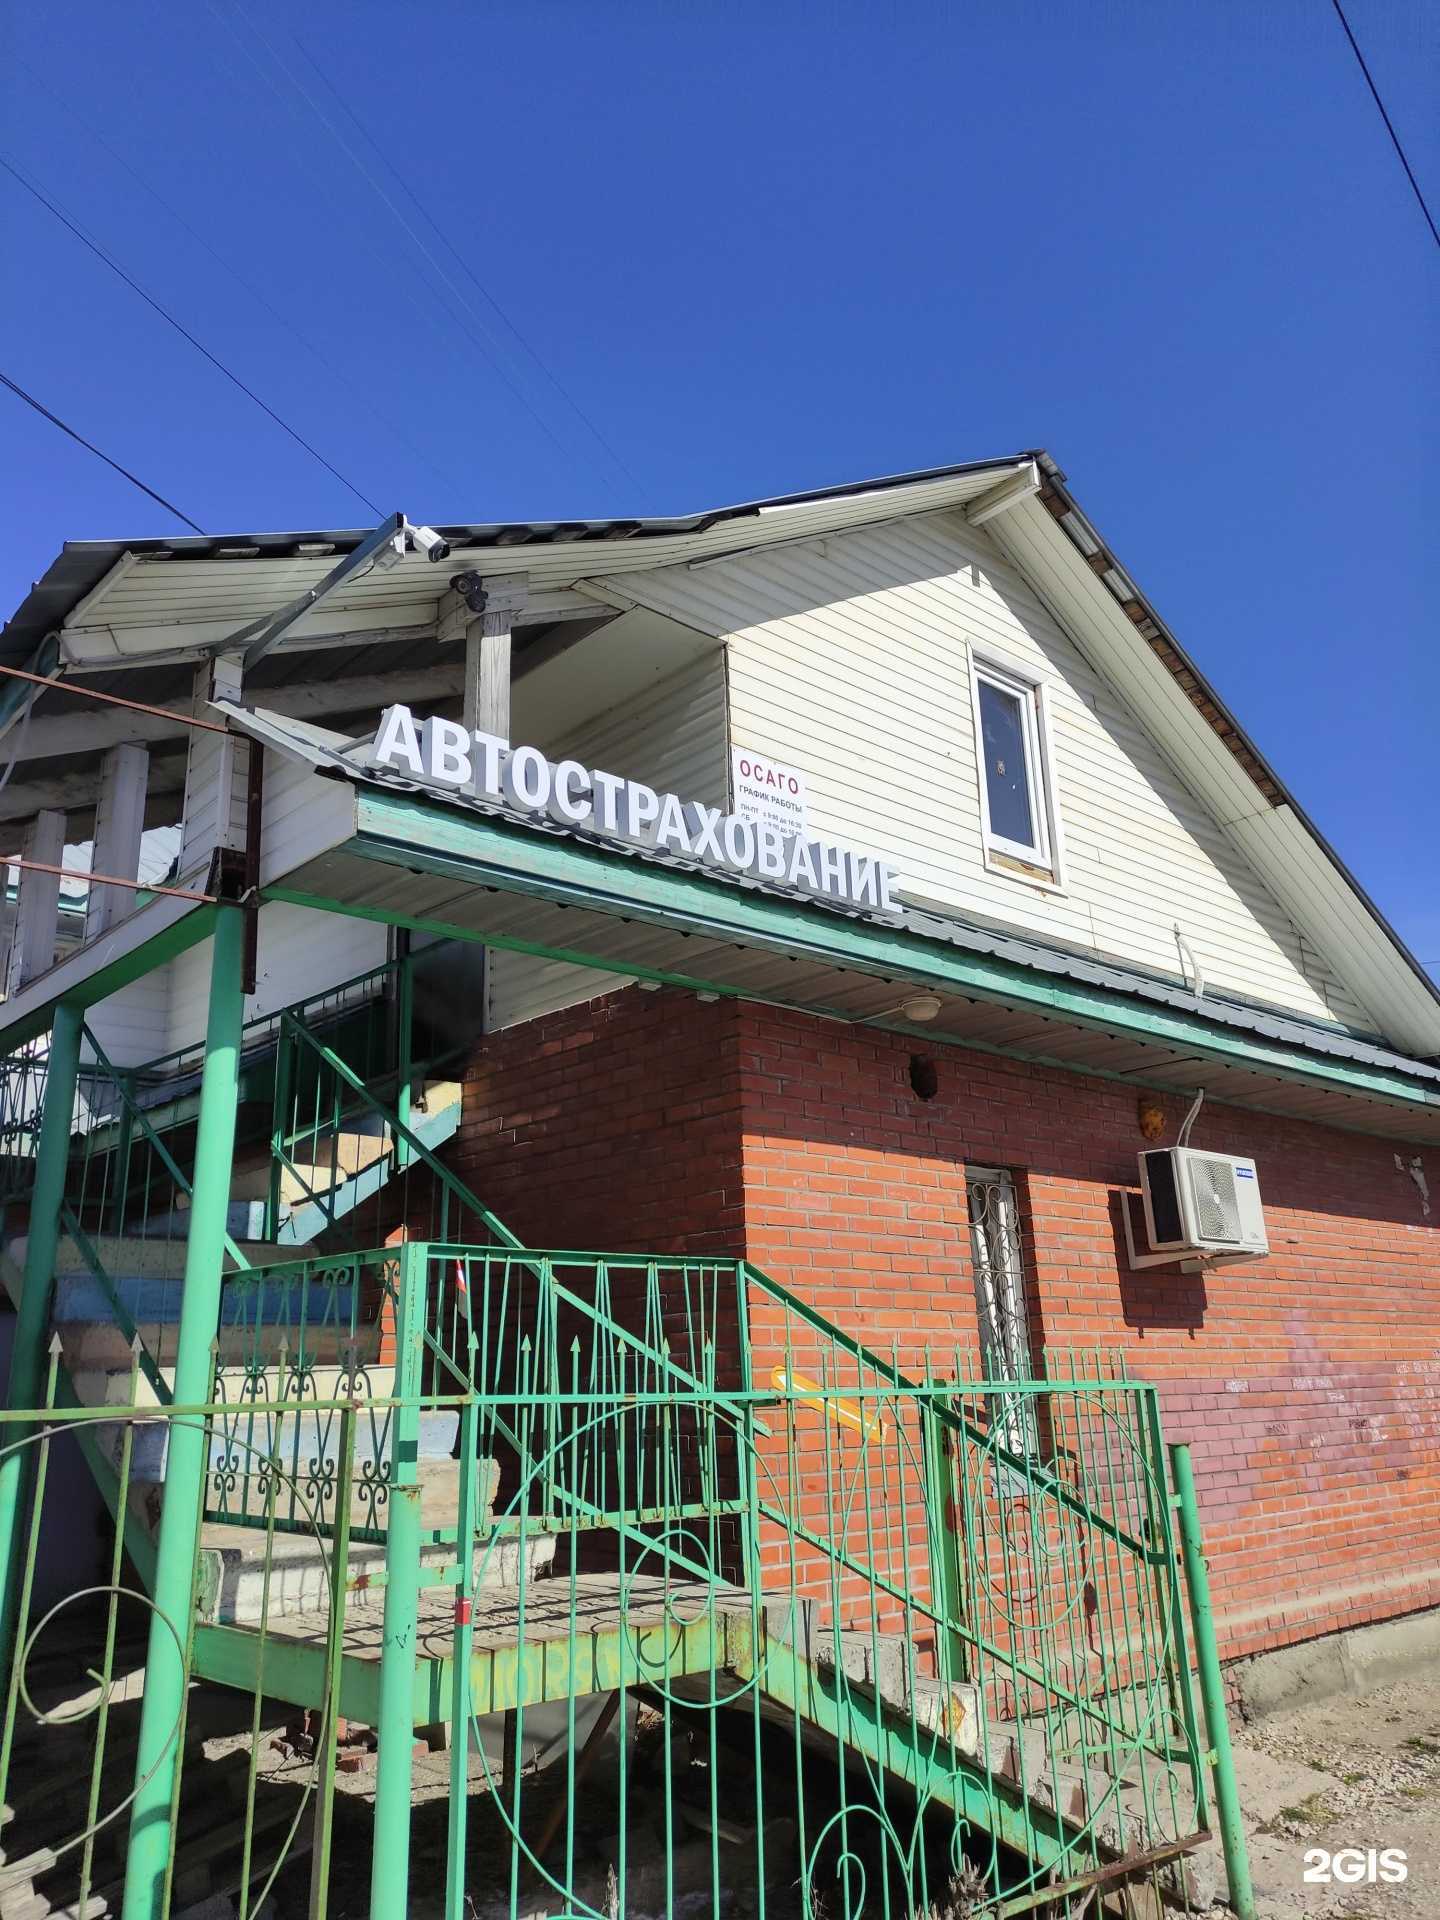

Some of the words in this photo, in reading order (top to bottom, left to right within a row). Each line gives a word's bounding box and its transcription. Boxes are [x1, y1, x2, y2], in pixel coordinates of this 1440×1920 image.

[739, 759, 799, 795] ОСАГО
[372, 703, 904, 914] АВТОСТРАХОВАНИЕ
[739, 784, 770, 802] ГРАФИК
[770, 795, 803, 813] РАБОТЫ
